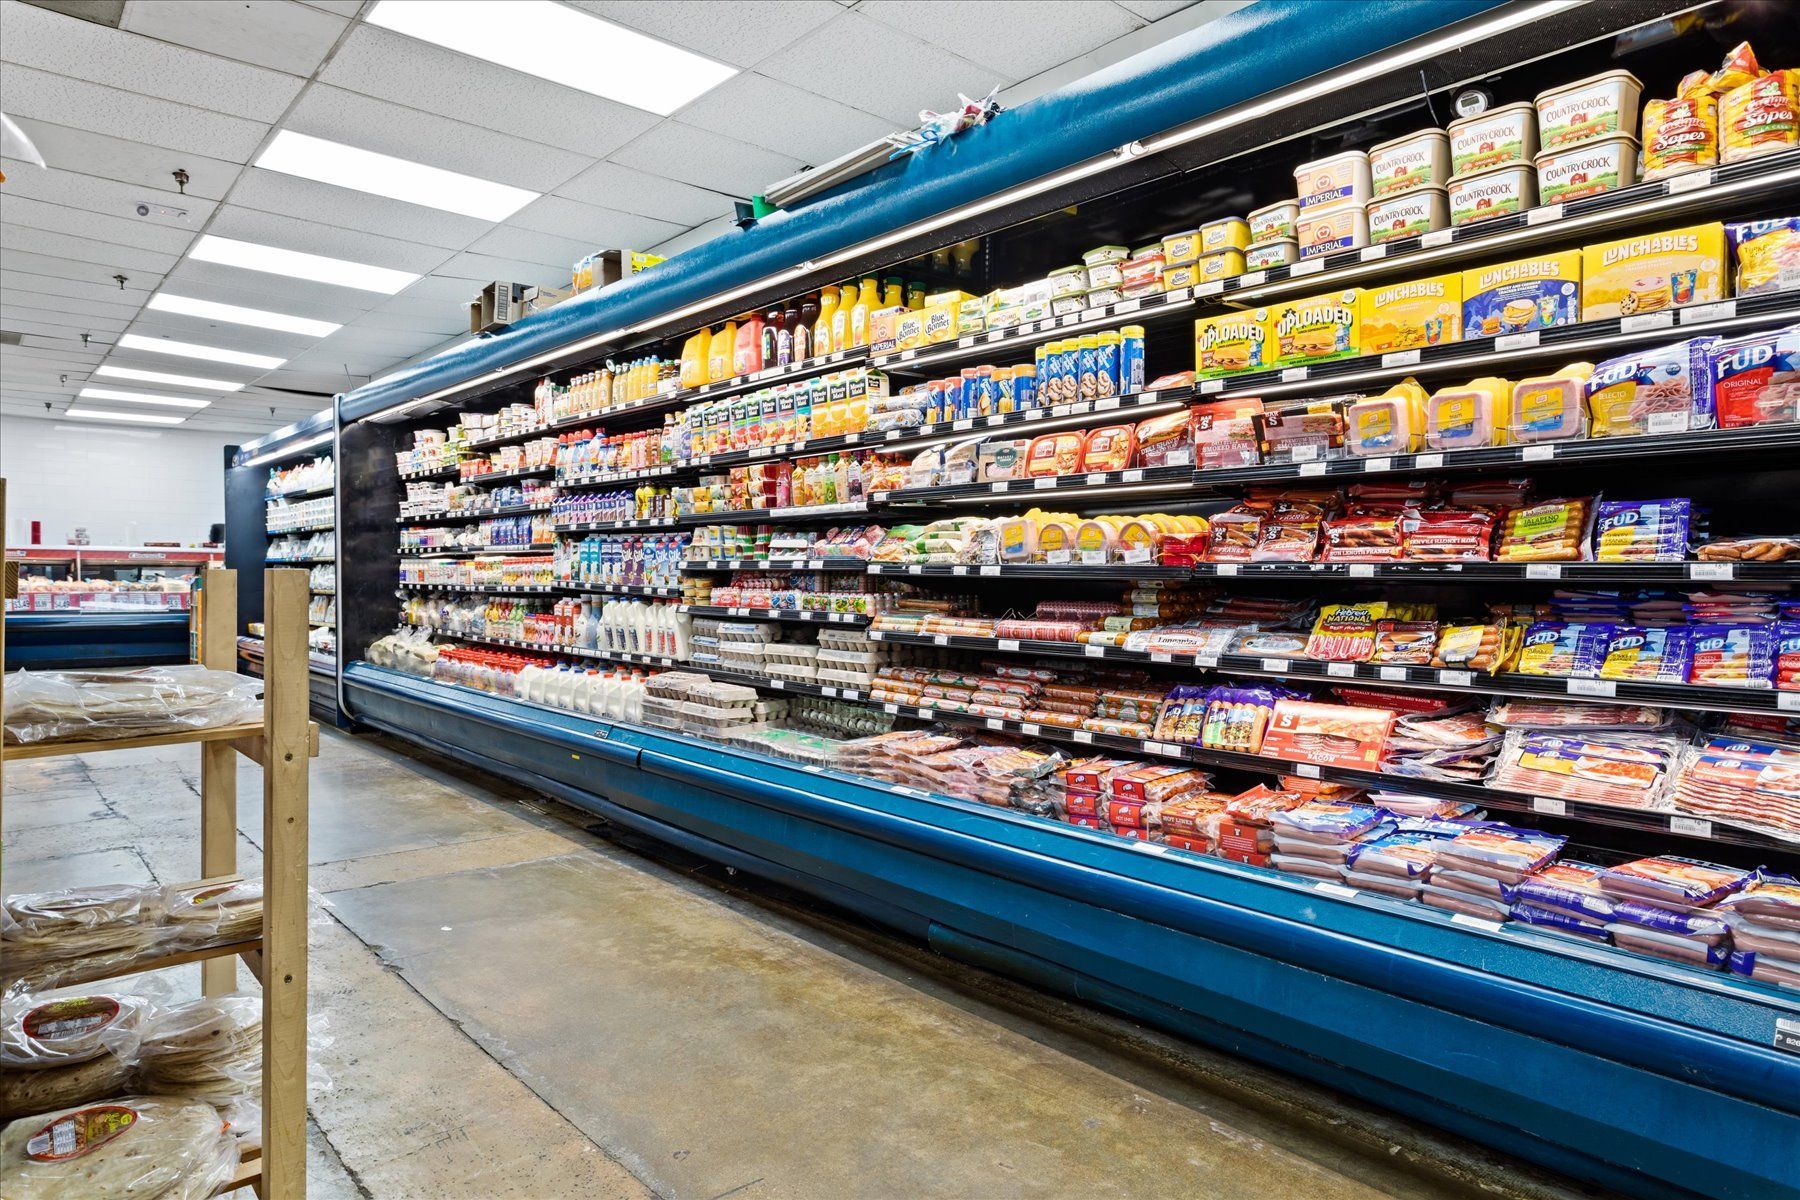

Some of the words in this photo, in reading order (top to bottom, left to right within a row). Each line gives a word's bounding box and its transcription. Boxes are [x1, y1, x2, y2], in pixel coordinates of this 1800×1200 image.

[1744, 110, 1793, 128] Sopes
[1657, 131, 1705, 150] Sopes
[1305, 189, 1344, 206] IMPERIAL
[1306, 240, 1344, 256] IMPERIAL
[1602, 234, 1698, 267] LUNCHABLES
[1479, 261, 1560, 290] LUNCHABLES
[1374, 282, 1445, 309] LUNCHABLES
[930, 313, 945, 323] Blue
[1277, 306, 1353, 337] UPLOADED
[898, 326, 920, 340] Bonnet
[902, 321, 915, 331] Blue
[927, 319, 949, 333] Bonnet
[1199, 324, 1265, 351] UPLOADED
[1716, 345, 1773, 380] FUD
[1723, 378, 1763, 389] ORIGINAL
[1268, 416, 1278, 426] S
[1601, 512, 1639, 531] FUD
[1215, 532, 1223, 541] S
[1327, 614, 1370, 623] NATIONAL
[1335, 608, 1368, 616] Hebrew
[1157, 636, 1198, 646] Longaniza
[1526, 631, 1559, 646] FUD
[1608, 636, 1645, 652] FUD
[1280, 714, 1293, 727] S
[1724, 744, 1751, 752] FUD
[1307, 753, 1336, 762] BACON
